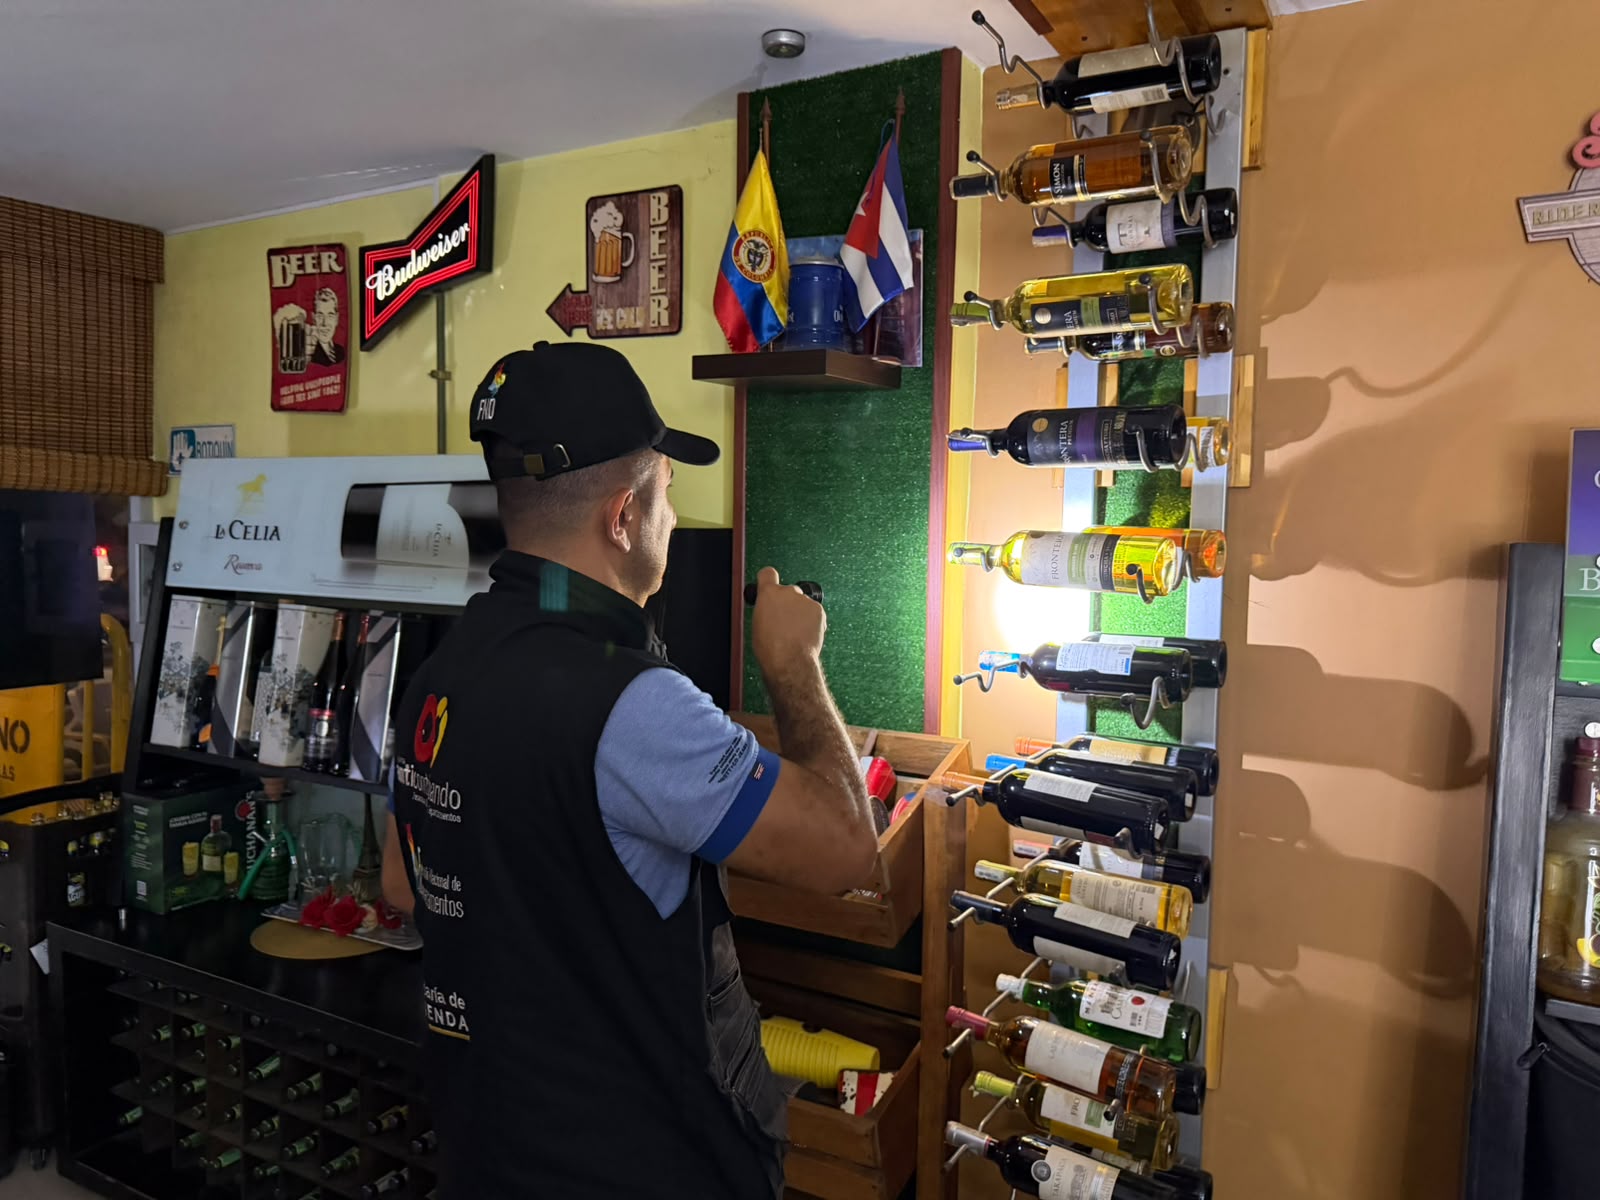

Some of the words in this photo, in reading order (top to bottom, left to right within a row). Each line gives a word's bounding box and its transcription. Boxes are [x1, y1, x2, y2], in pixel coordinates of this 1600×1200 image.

[1053, 163, 1062, 195] SIMON
[270, 251, 344, 288] BEER
[365, 222, 470, 300] Budweiser
[650, 192, 669, 328] BEER
[477, 398, 496, 421] FND
[246, 790, 256, 870] UCHANAN'S
[452, 875, 462, 892] de
[424, 983, 447, 1005] aría
[449, 991, 466, 1010] de
[425, 1003, 469, 1032] ENDA
